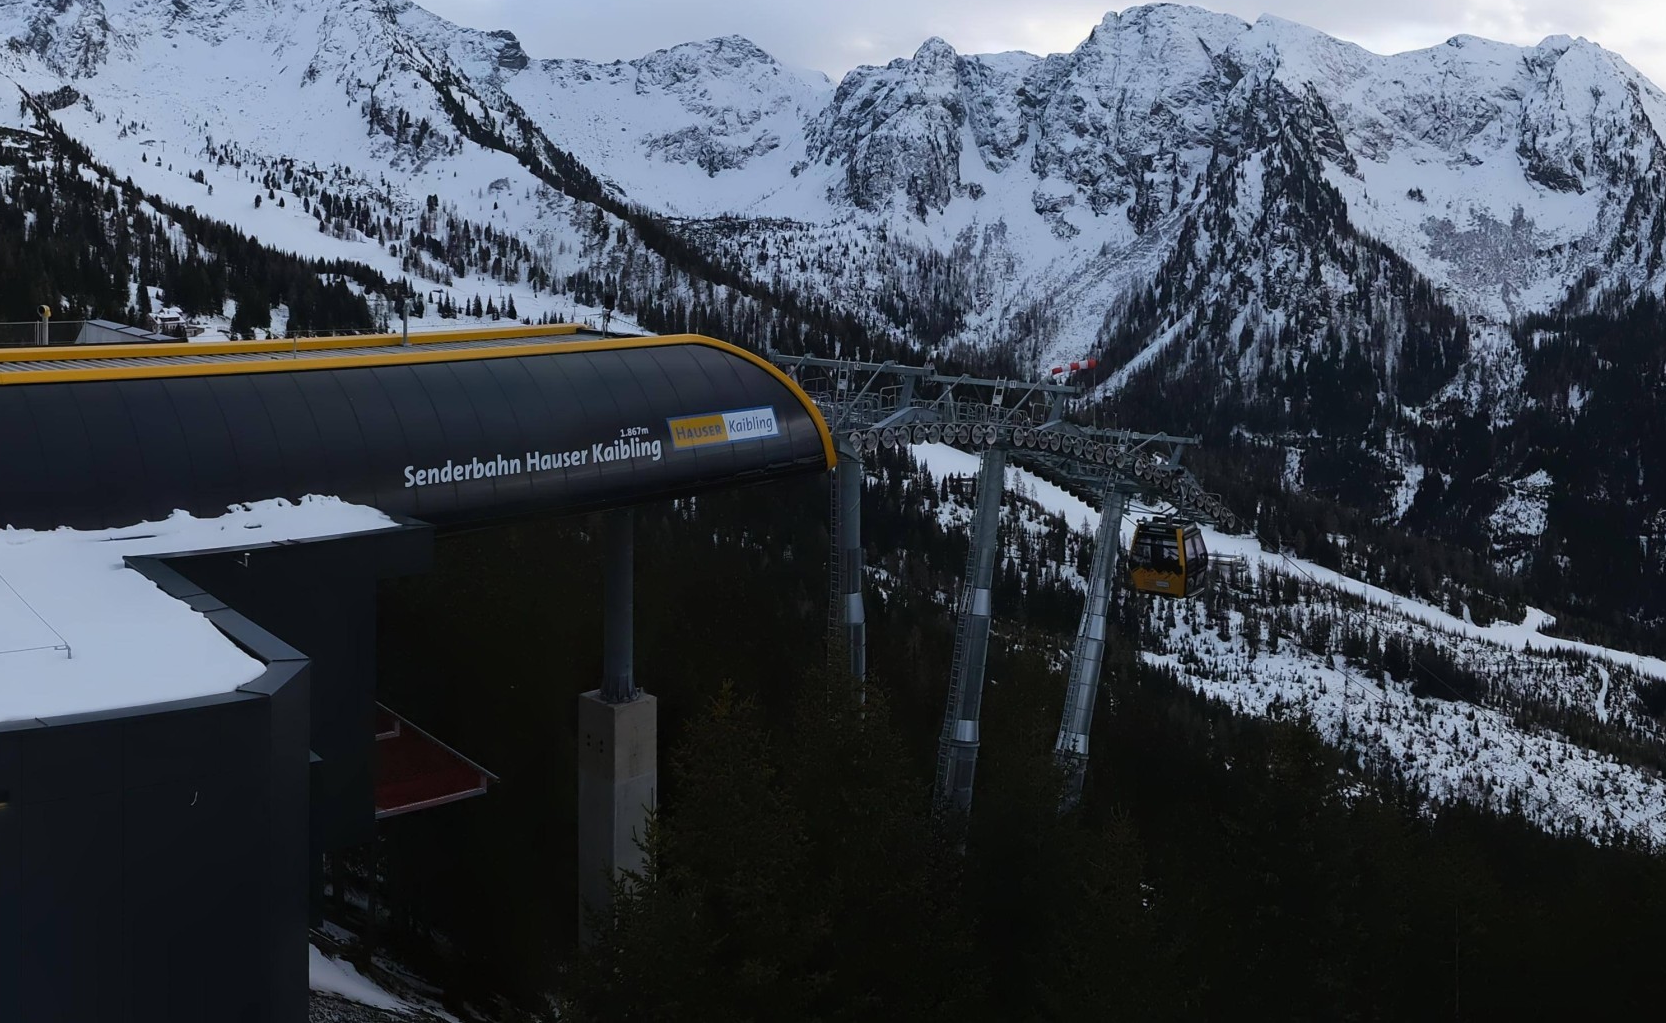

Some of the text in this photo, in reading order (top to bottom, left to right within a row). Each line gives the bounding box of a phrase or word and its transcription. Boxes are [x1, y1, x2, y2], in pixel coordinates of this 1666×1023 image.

[620, 427, 649, 438] 1.867m
[675, 416, 773, 440] HAUSER Kaibling
[404, 437, 662, 488] Senderbahn Hauser Kaibling
